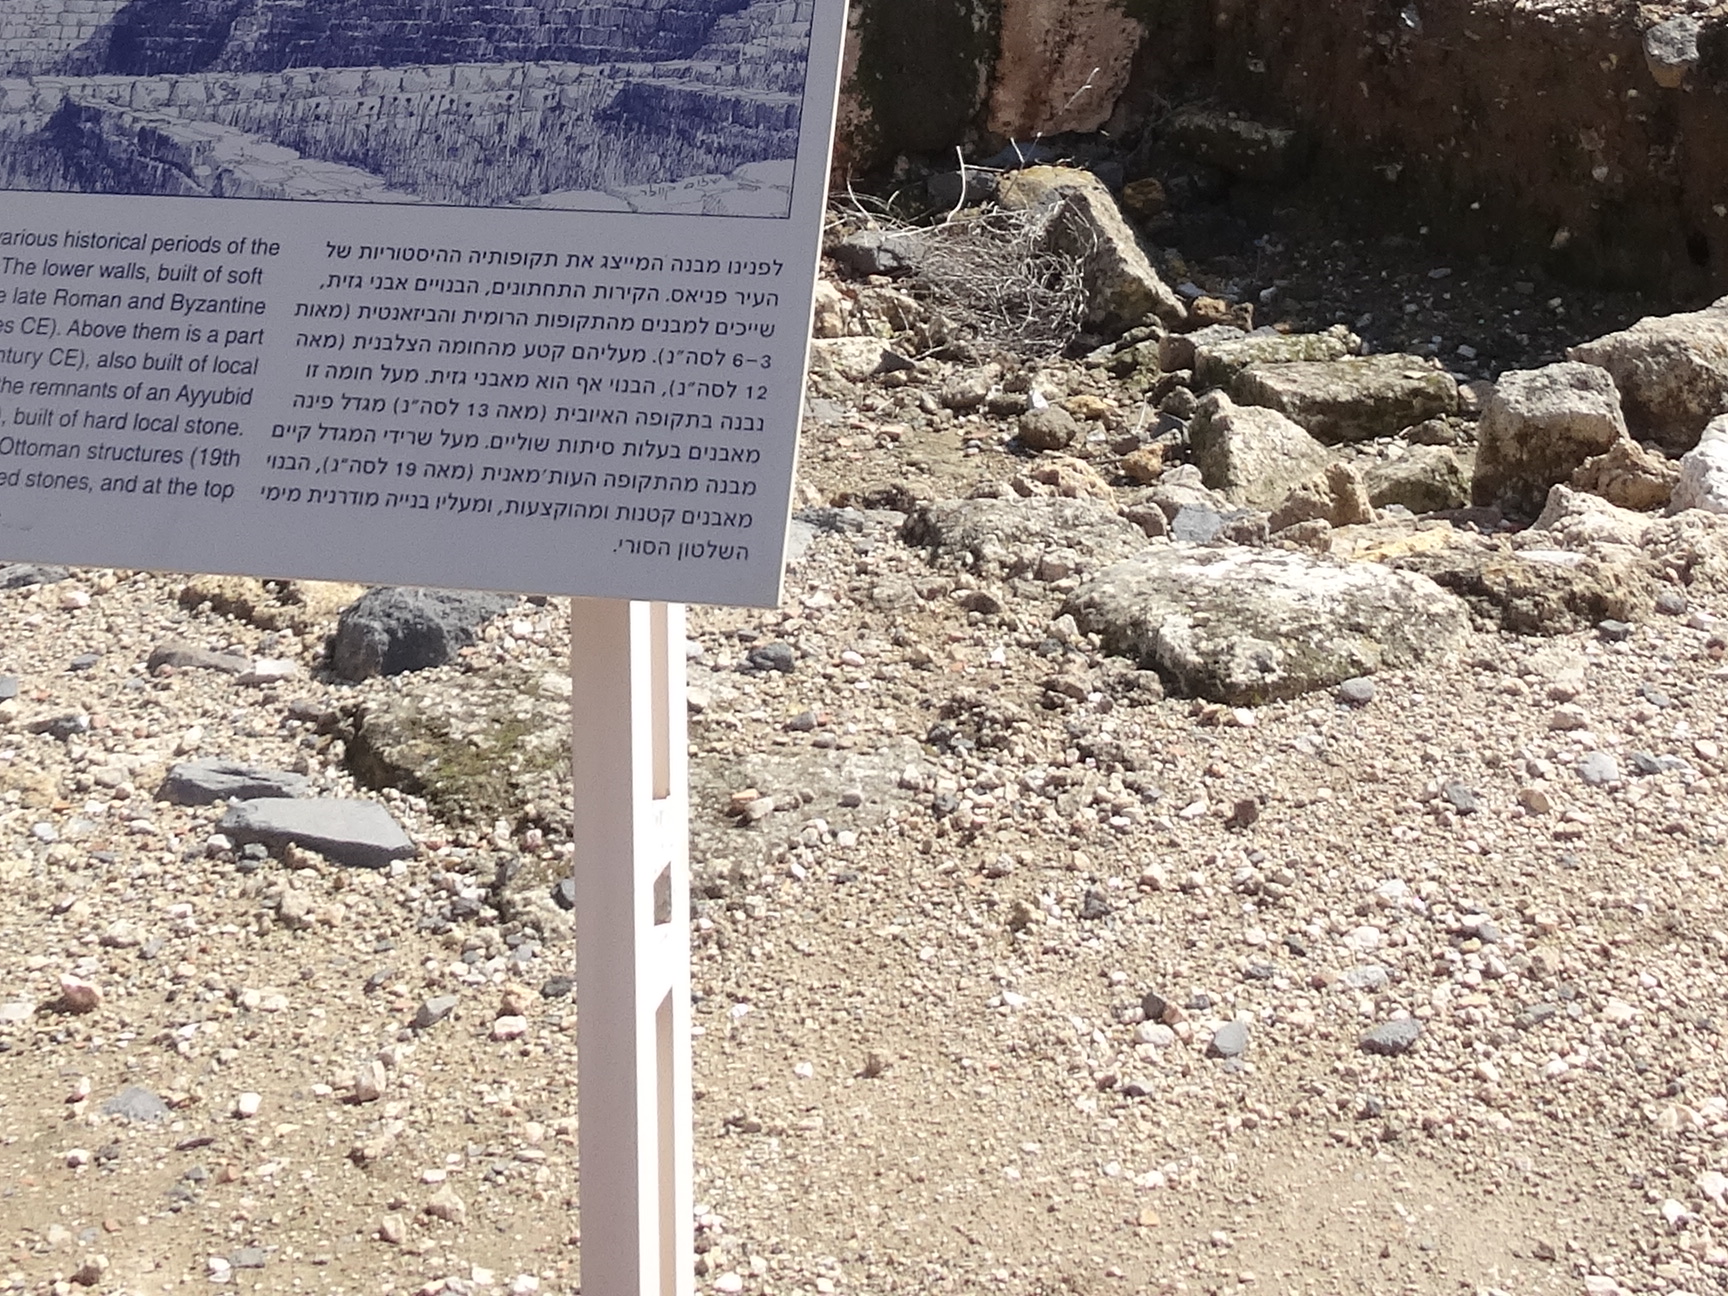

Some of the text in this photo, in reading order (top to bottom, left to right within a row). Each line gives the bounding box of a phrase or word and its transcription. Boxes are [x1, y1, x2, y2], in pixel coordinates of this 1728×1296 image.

[62, 229, 148, 251] historical
[148, 233, 222, 256] periods
[225, 235, 248, 255] of
[249, 236, 281, 256] the
[1, 255, 37, 276] The
[41, 257, 95, 278] lower
[98, 261, 150, 284] walls,
[156, 262, 198, 283] built
[201, 264, 224, 284] of
[225, 265, 263, 286] soft
[325, 239, 784, 276] לפנינו מבנה המייצג את תקופותיה ההיסטוריות של
[368, 275, 409, 291] אבני
[413, 276, 480, 294] הבנויים
[591, 284, 660, 305] הקירות
[734, 290, 779, 308] העיר
[19, 315, 62, 339] CE).
[64, 318, 127, 339] Above
[131, 321, 180, 341] them
[184, 322, 202, 343] is
[205, 327, 219, 344] a
[222, 327, 265, 349] part
[47, 346, 90, 372] CE),
[95, 349, 137, 370] also
[141, 351, 184, 372] built
[186, 353, 209, 373] of
[211, 354, 260, 376] local
[28, 380, 118, 400] remnants
[121, 380, 144, 400] of
[144, 385, 171, 402] an
[173, 383, 254, 409] Ayyubid
[12, 405, 54, 427] built
[57, 408, 80, 428] of
[81, 409, 129, 431] hard
[131, 411, 180, 433] local
[182, 416, 244, 437] stone.
[85, 441, 184, 465] structures
[188, 445, 241, 470] (19th
[23, 470, 93, 494] stones,
[98, 473, 139, 494] and
[140, 476, 163, 495] at
[166, 475, 199, 497] the
[202, 478, 235, 504] top
[676, 538, 749, 562] השלטון
